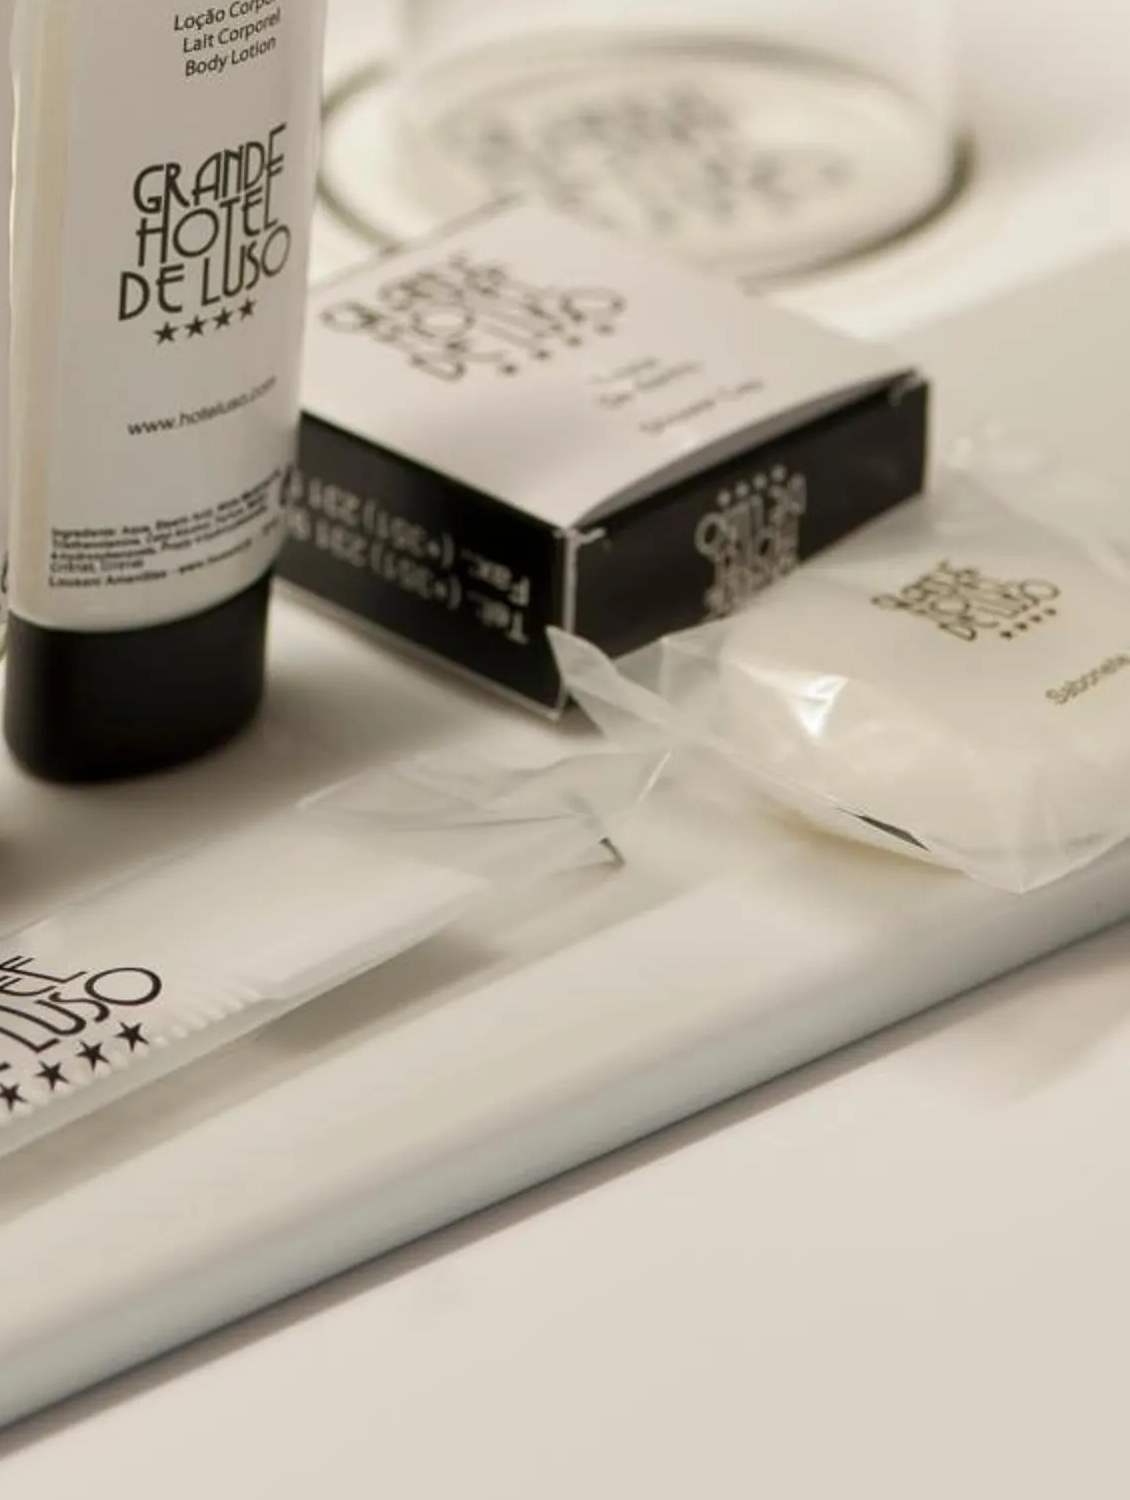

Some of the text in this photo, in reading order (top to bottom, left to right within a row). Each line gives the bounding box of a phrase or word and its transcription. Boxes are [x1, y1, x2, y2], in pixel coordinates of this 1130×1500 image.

[174, 7, 226, 31] Loção
[183, 6, 281, 53] Lait Corporel
[185, 36, 276, 77] Body Lotion
[133, 120, 287, 216] GRANDE
[135, 186, 278, 268] HOTEL
[118, 224, 291, 322] DE LUSO
